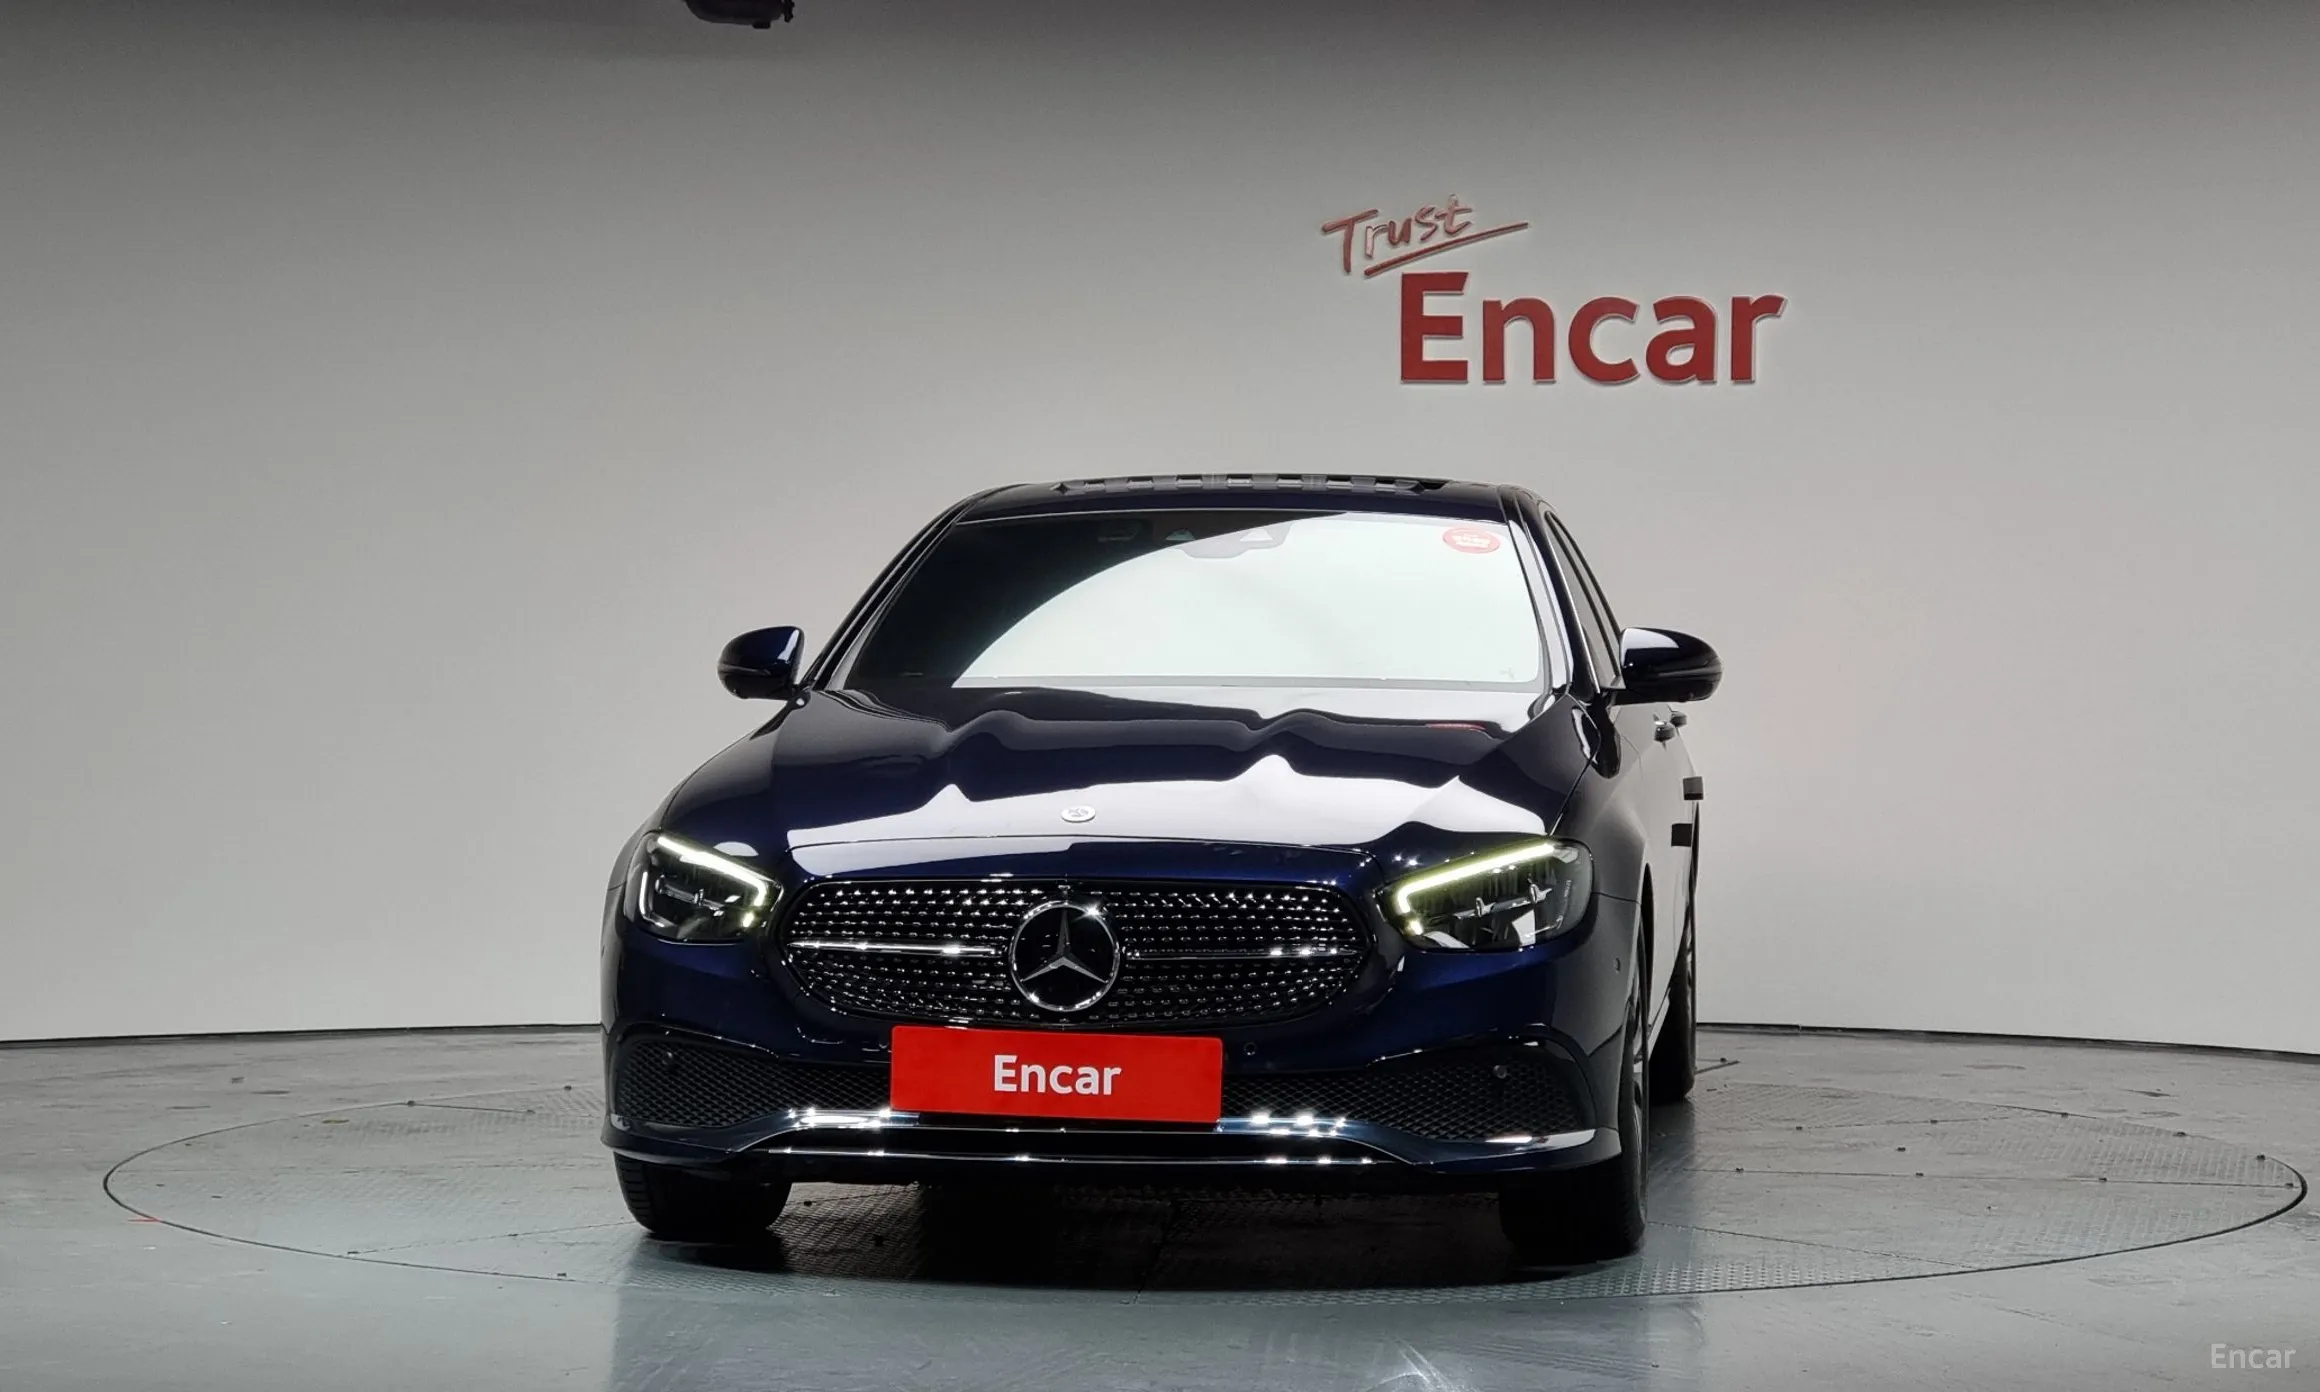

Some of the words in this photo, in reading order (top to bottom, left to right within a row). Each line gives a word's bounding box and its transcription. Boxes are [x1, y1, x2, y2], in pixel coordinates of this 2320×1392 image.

[1321, 194, 1473, 274] Trust
[1401, 271, 1787, 385] Encar
[993, 1054, 1122, 1095] Encar
